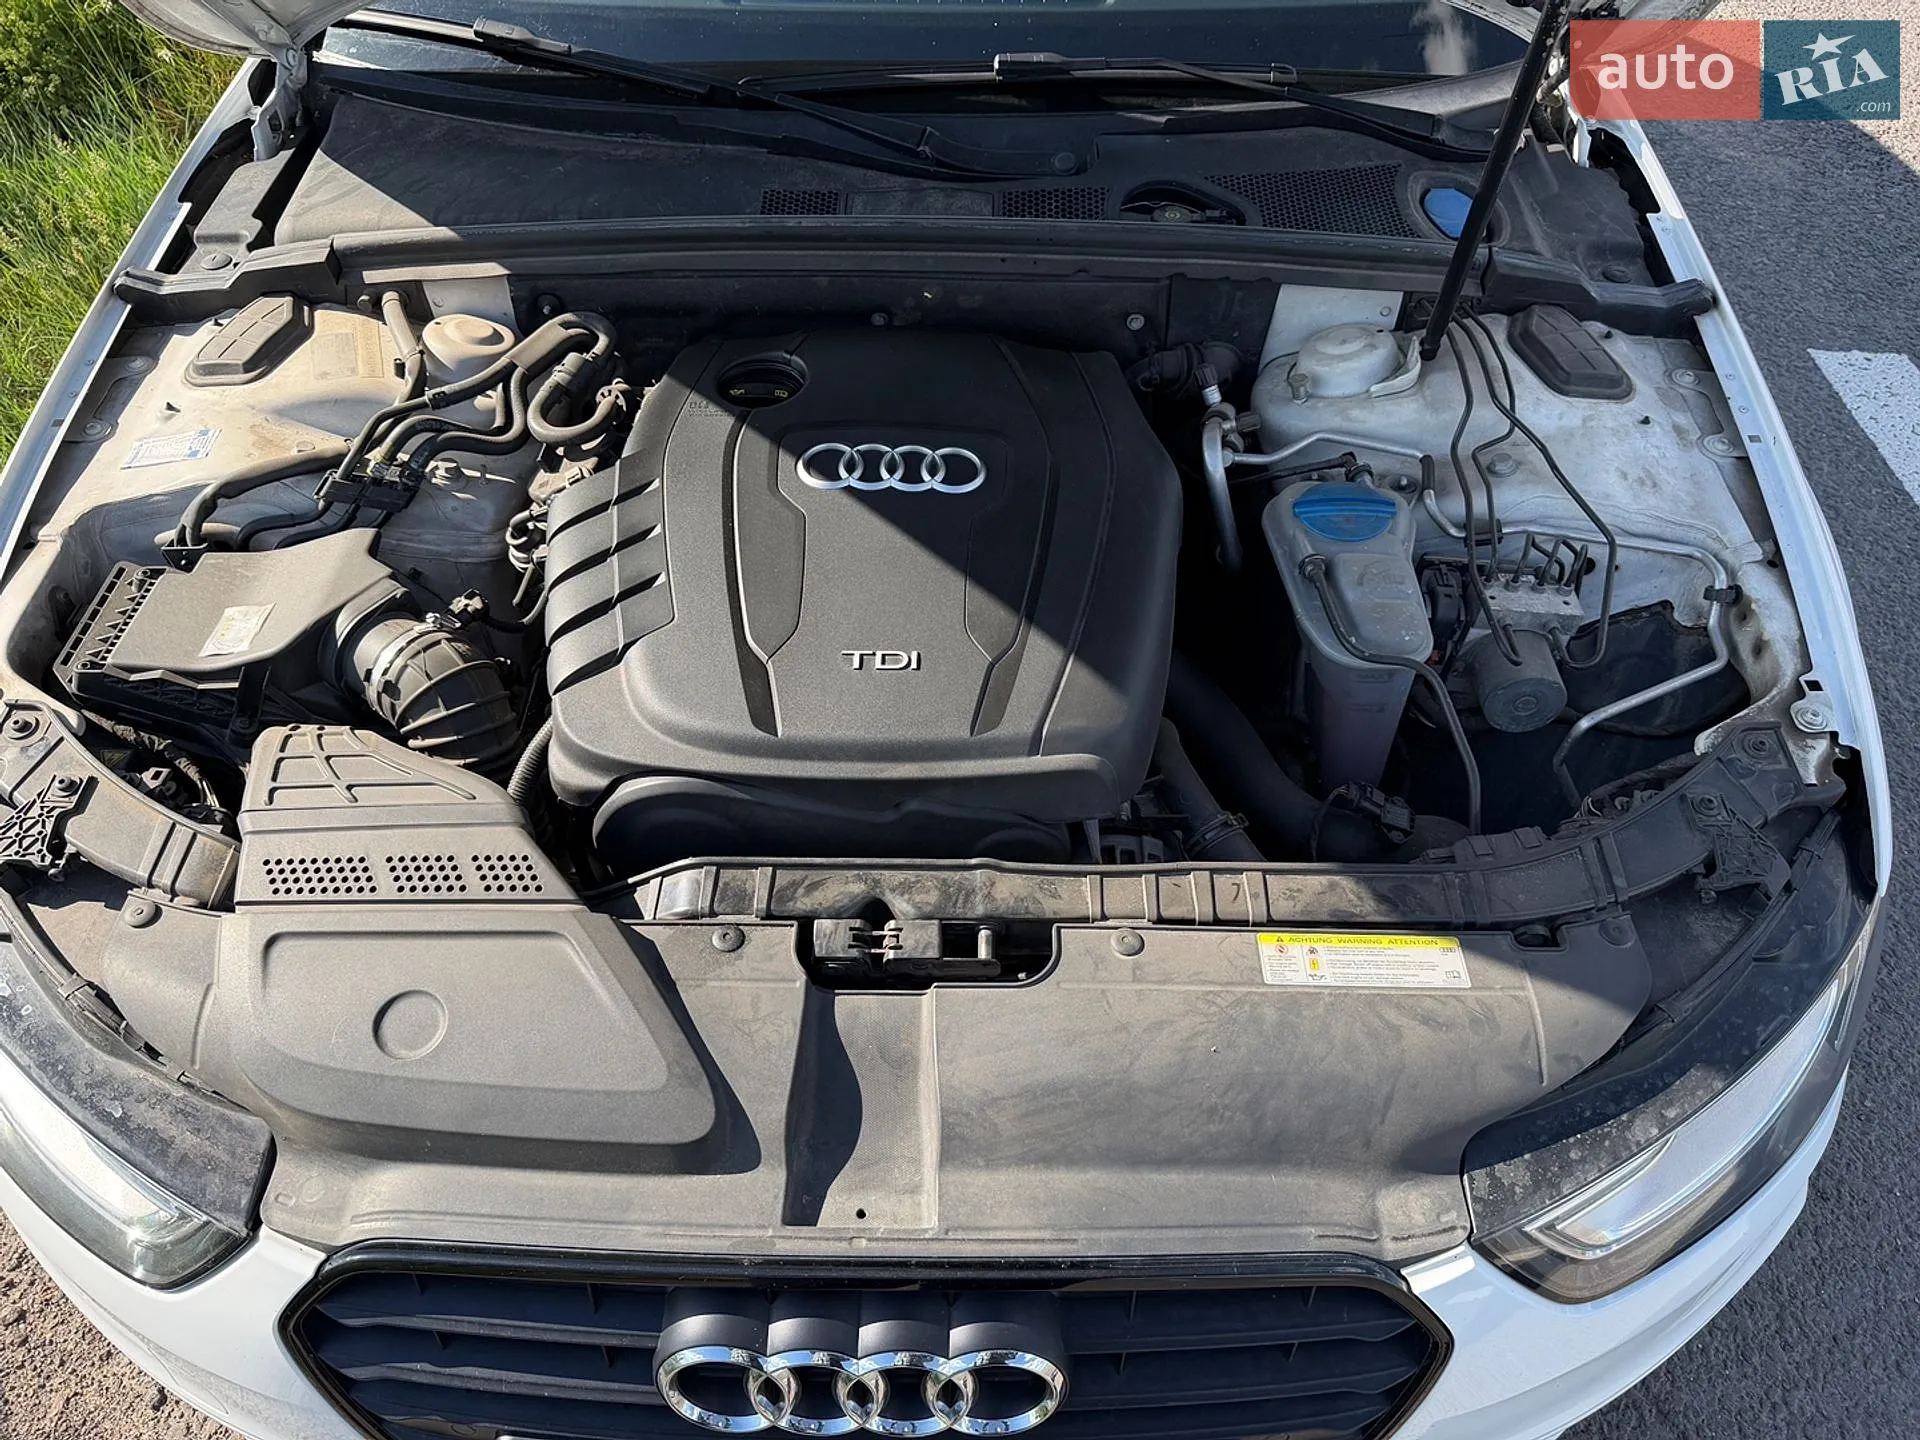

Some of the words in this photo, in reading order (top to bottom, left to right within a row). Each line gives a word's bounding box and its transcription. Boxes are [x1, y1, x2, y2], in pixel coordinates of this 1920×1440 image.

[841, 650, 922, 671] TDI
[1288, 936, 1333, 944] ACHTUNG
[1336, 937, 1383, 945] WARNING
[1387, 938, 1439, 946] ATTENTION
